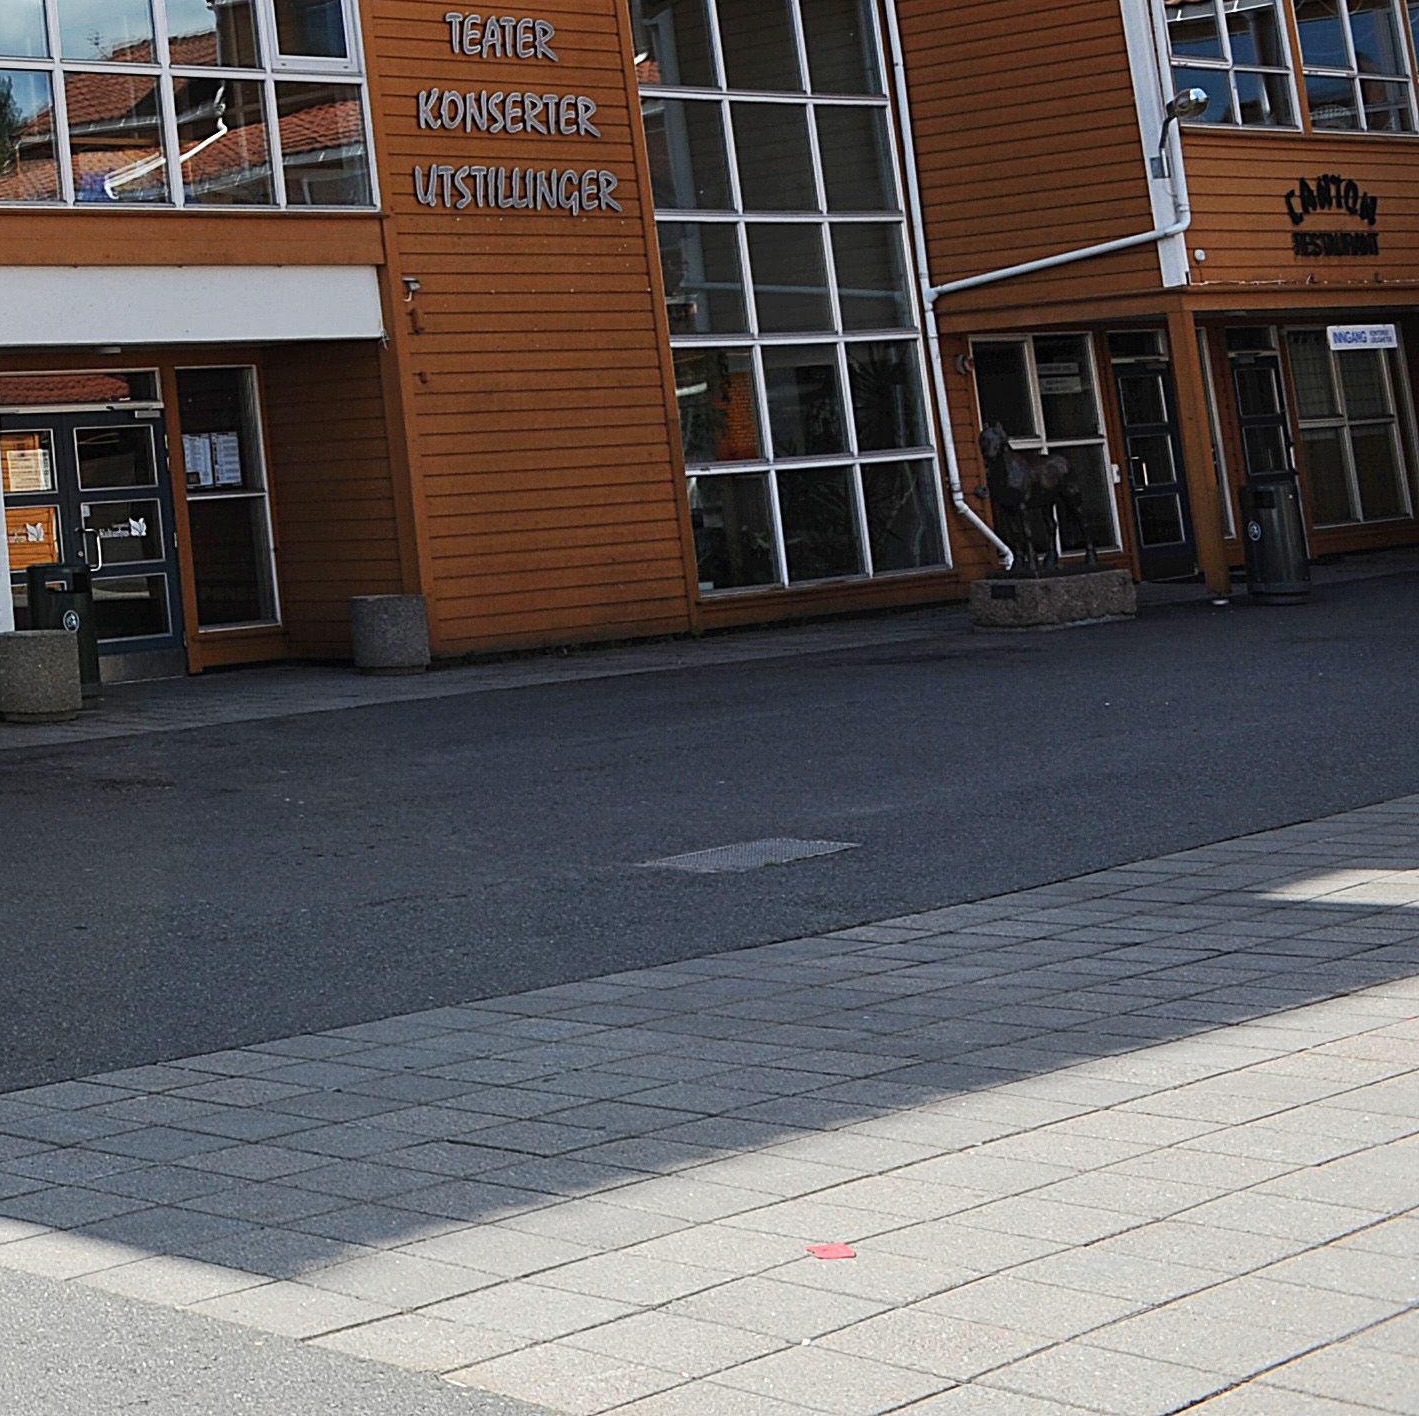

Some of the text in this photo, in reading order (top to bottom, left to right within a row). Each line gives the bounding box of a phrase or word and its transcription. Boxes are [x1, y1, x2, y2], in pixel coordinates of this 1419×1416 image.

[445, 12, 559, 63] TEATER
[418, 87, 601, 137] KONSERTER
[414, 164, 623, 216] UTSTILLINGER
[1285, 173, 1377, 225] CANTON
